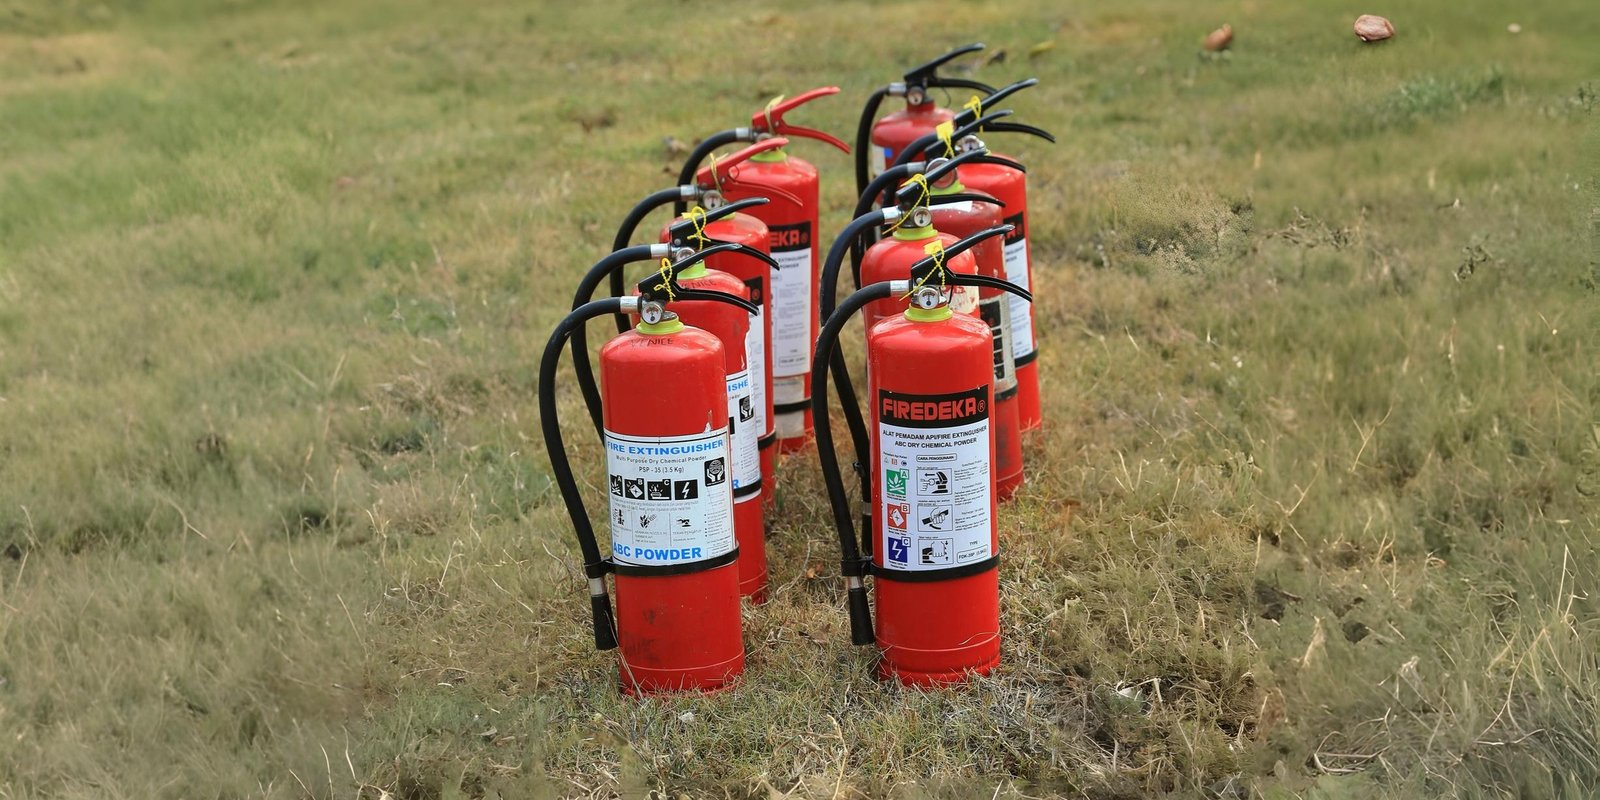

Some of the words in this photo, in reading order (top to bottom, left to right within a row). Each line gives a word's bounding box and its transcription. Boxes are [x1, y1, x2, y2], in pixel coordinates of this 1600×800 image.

[882, 397, 977, 420] FIREDEKA
[883, 429, 894, 437] ALAT
[895, 432, 924, 440] PEMADAM
[952, 425, 987, 439] EXTINGUISHER
[607, 441, 625, 452] FIRE
[628, 439, 724, 455] EXTINGUISHER
[954, 437, 977, 446] POWDER
[901, 470, 908, 478] A
[903, 538, 909, 546] C
[613, 542, 631, 557] ABC
[635, 547, 702, 561] POWDER
